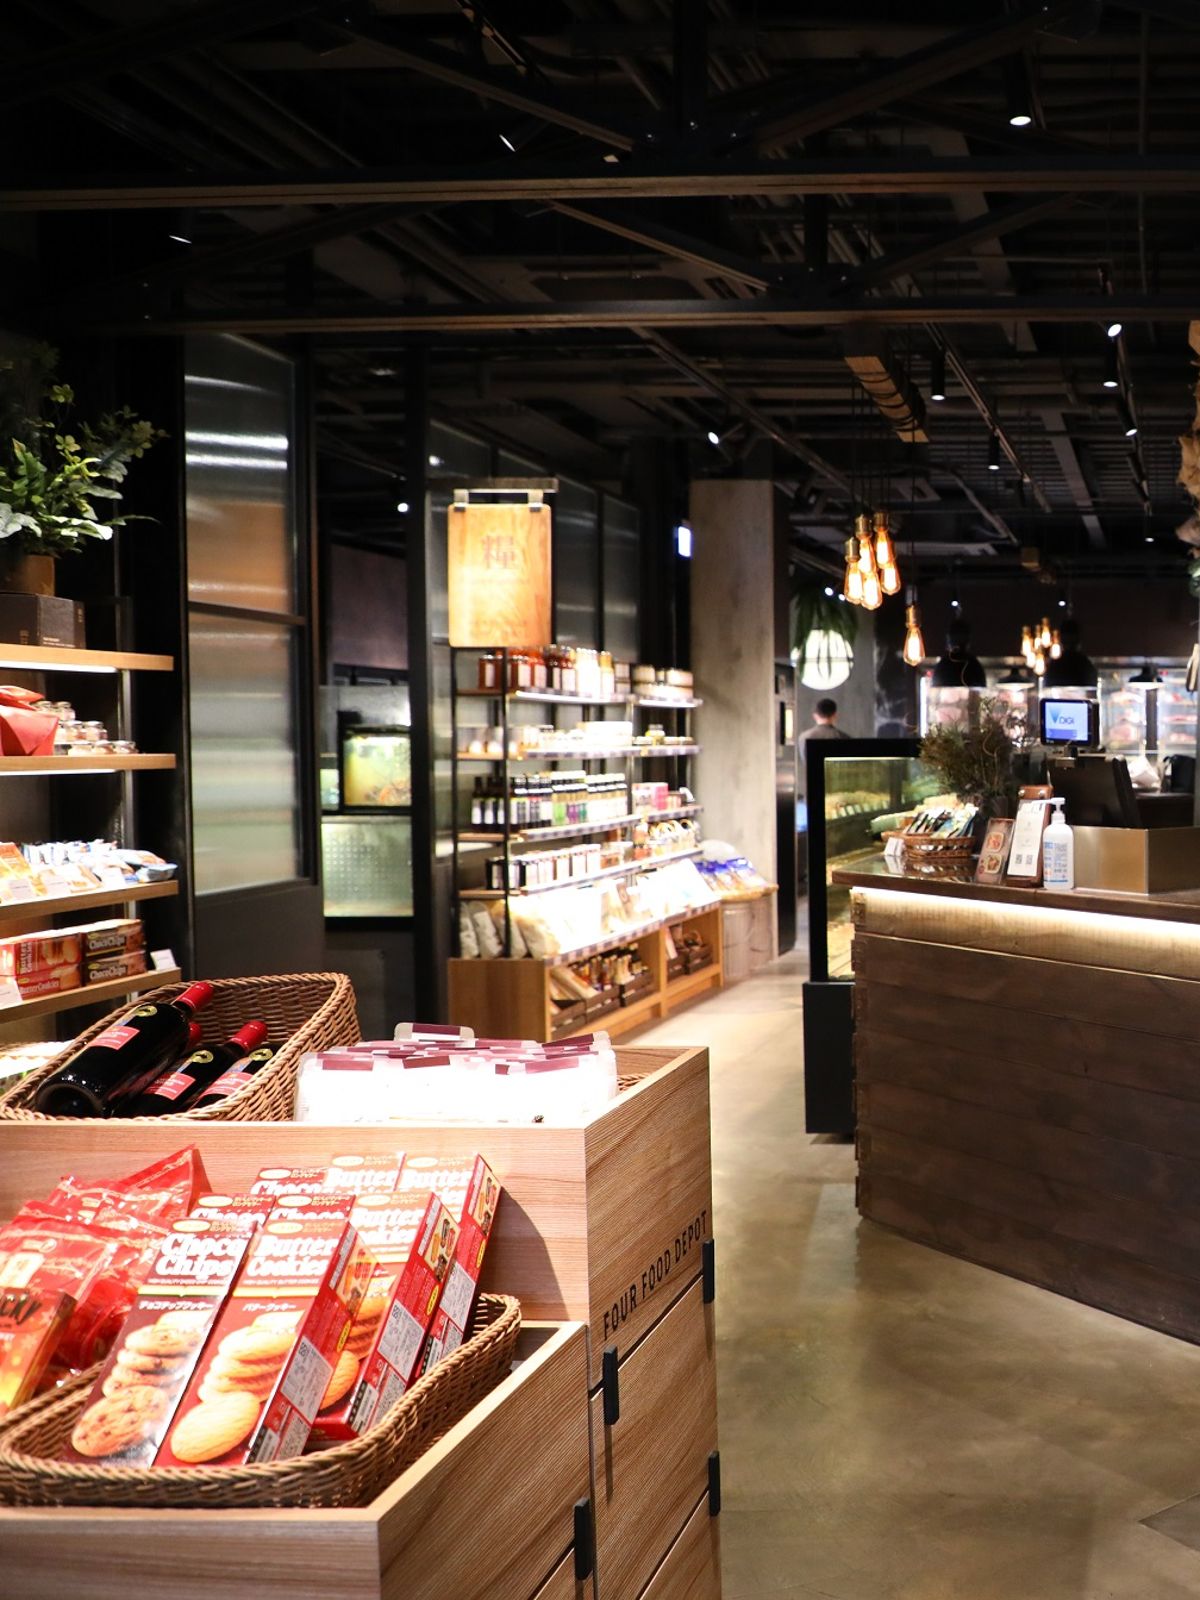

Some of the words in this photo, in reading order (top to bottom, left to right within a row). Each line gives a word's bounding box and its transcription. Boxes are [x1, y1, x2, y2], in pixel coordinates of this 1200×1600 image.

[350, 1207, 427, 1228] Butter
[160, 1233, 250, 1257] Choco
[253, 1235, 340, 1257] Butter
[155, 1255, 235, 1281] Chips
[247, 1255, 330, 1277] Cookies
[602, 1284, 638, 1341] FOUR
[641, 1249, 671, 1300] FOOD
[674, 1210, 707, 1264] DEPOT
